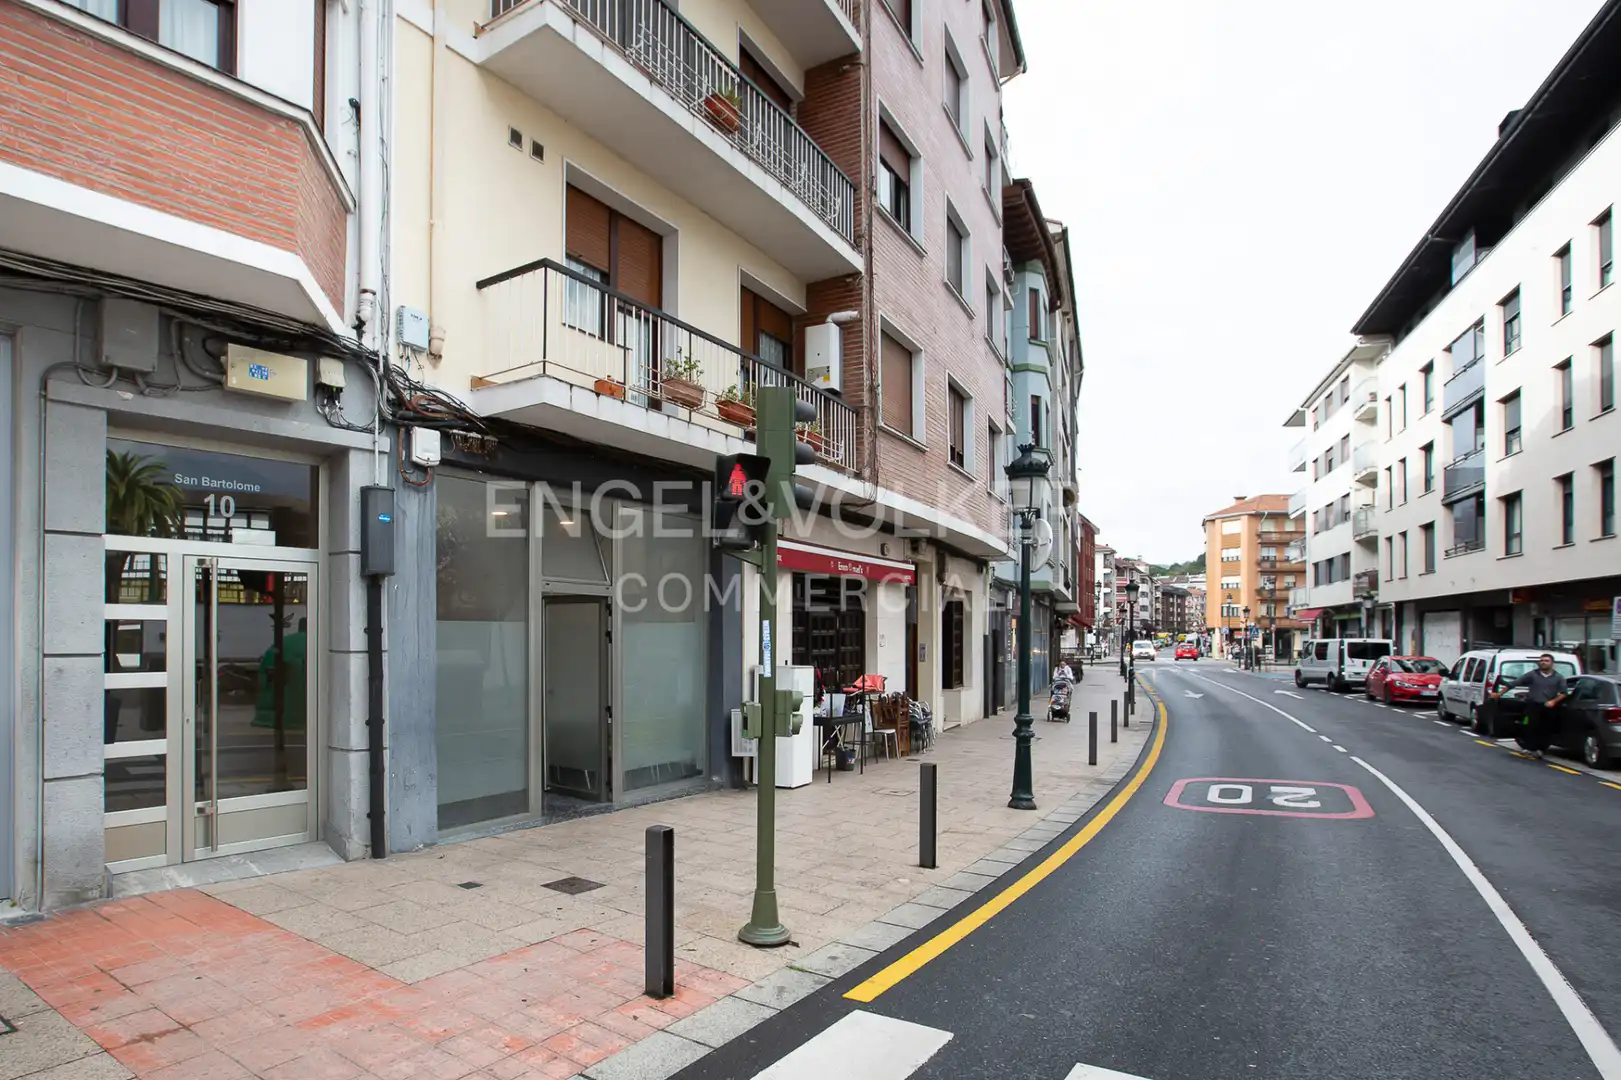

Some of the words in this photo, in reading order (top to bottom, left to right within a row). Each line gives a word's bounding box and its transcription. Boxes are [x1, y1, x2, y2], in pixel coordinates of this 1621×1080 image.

[174, 473, 198, 486] San
[201, 476, 261, 492] Bartolome
[203, 493, 236, 518] 10
[1207, 783, 1321, 808] 20
